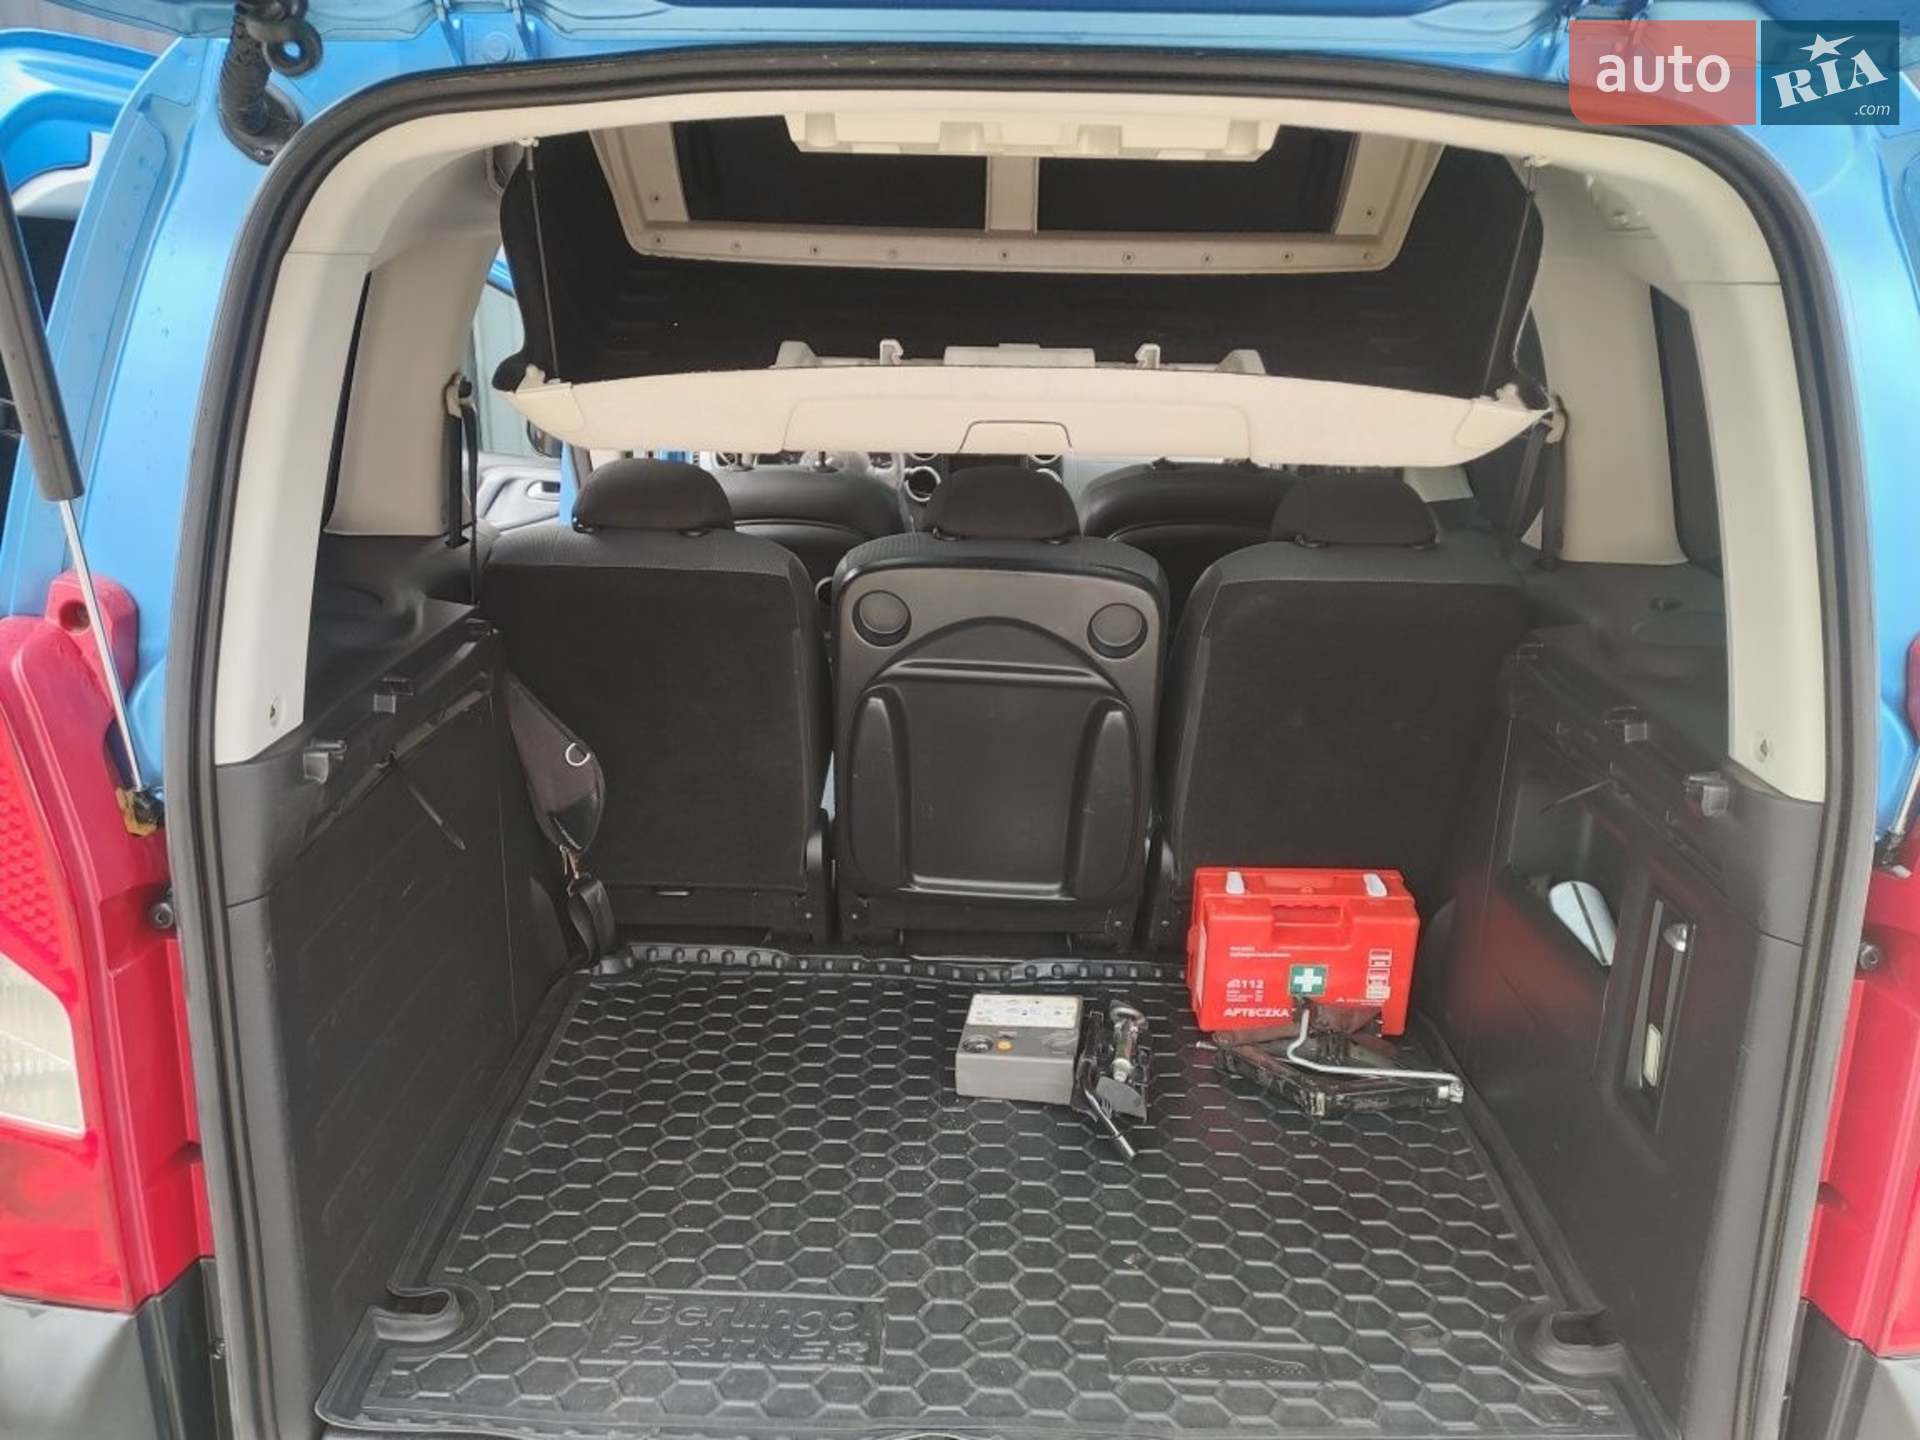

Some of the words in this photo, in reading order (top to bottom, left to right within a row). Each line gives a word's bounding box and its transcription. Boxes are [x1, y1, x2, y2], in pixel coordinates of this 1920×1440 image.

[1241, 979, 1264, 989] 112
[1224, 1007, 1290, 1018] APTECZKA
[631, 1294, 860, 1338] Berlingo
[601, 1335, 869, 1362] PARTNER
